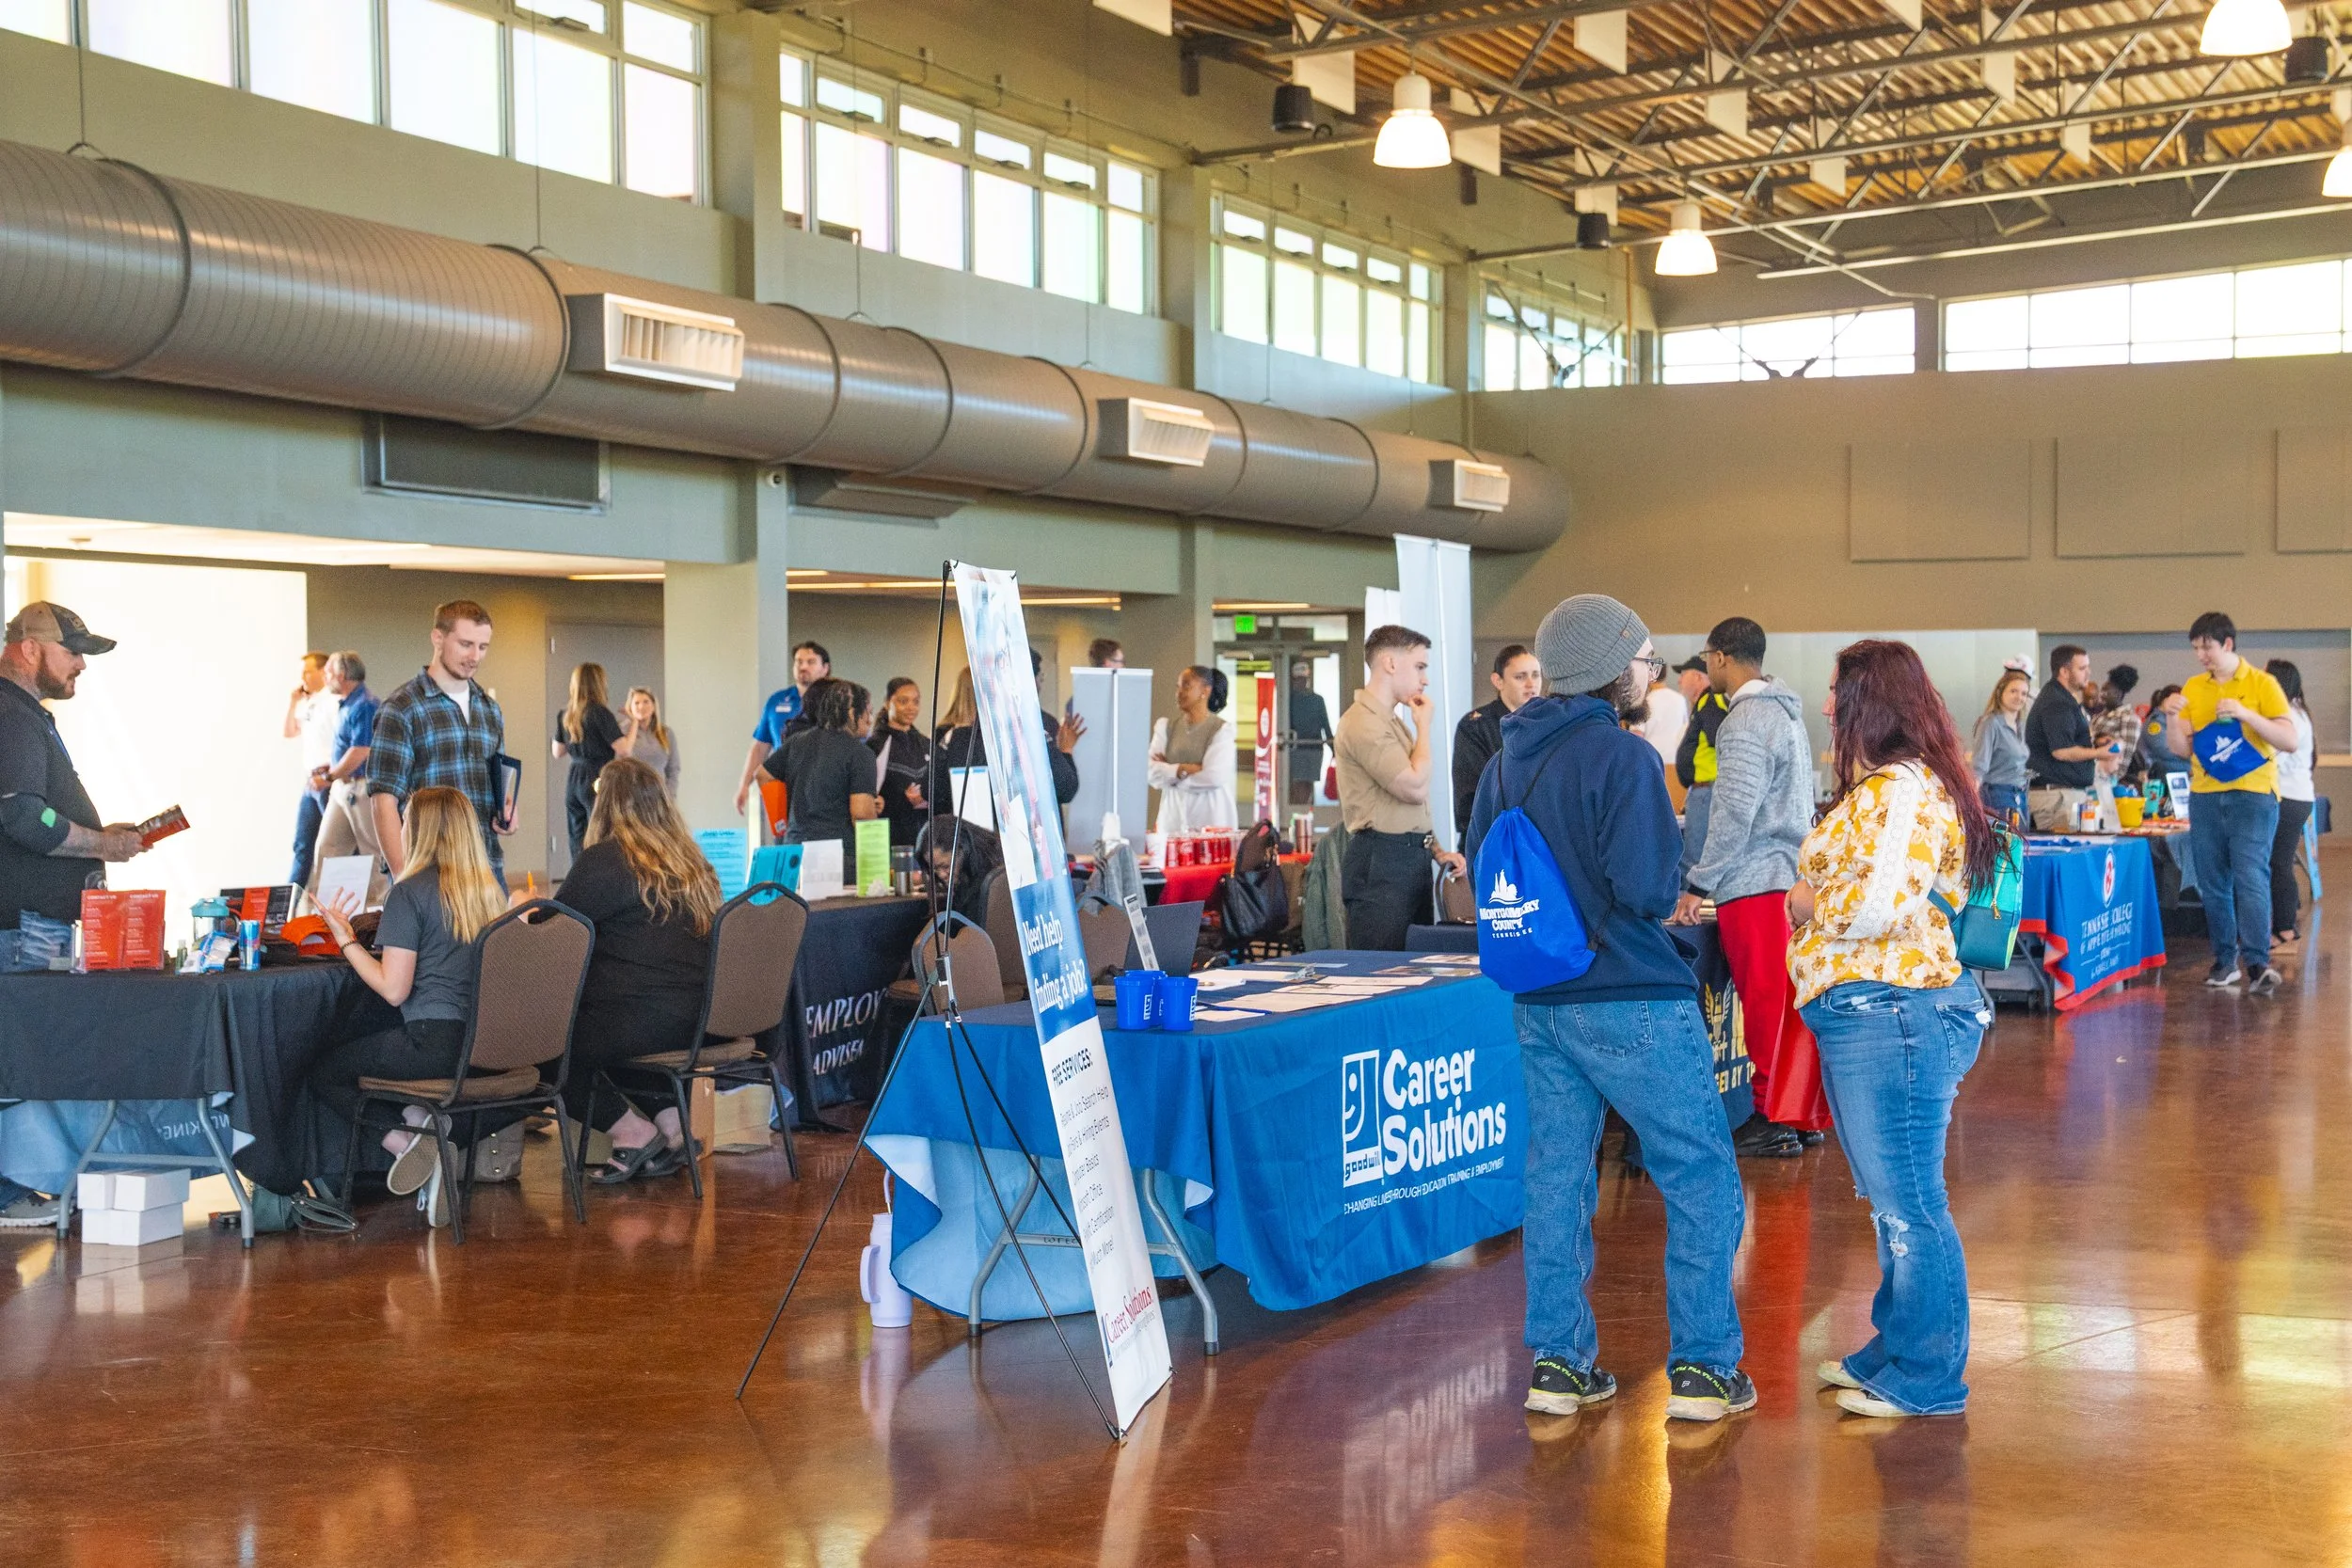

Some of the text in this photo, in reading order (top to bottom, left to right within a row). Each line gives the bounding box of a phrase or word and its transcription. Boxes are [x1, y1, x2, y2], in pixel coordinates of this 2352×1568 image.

[1479, 898, 1540, 920] MONTGOMERY
[1023, 911, 1063, 956] Need help
[1060, 975, 1070, 999] a
[1066, 958, 1088, 1005] job?
[1383, 1048, 1475, 1110] Career
[1383, 1096, 1506, 1175] Solutions
[1391, 1185, 1422, 1200] HROUGH
[1104, 1311, 1129, 1343] Career
